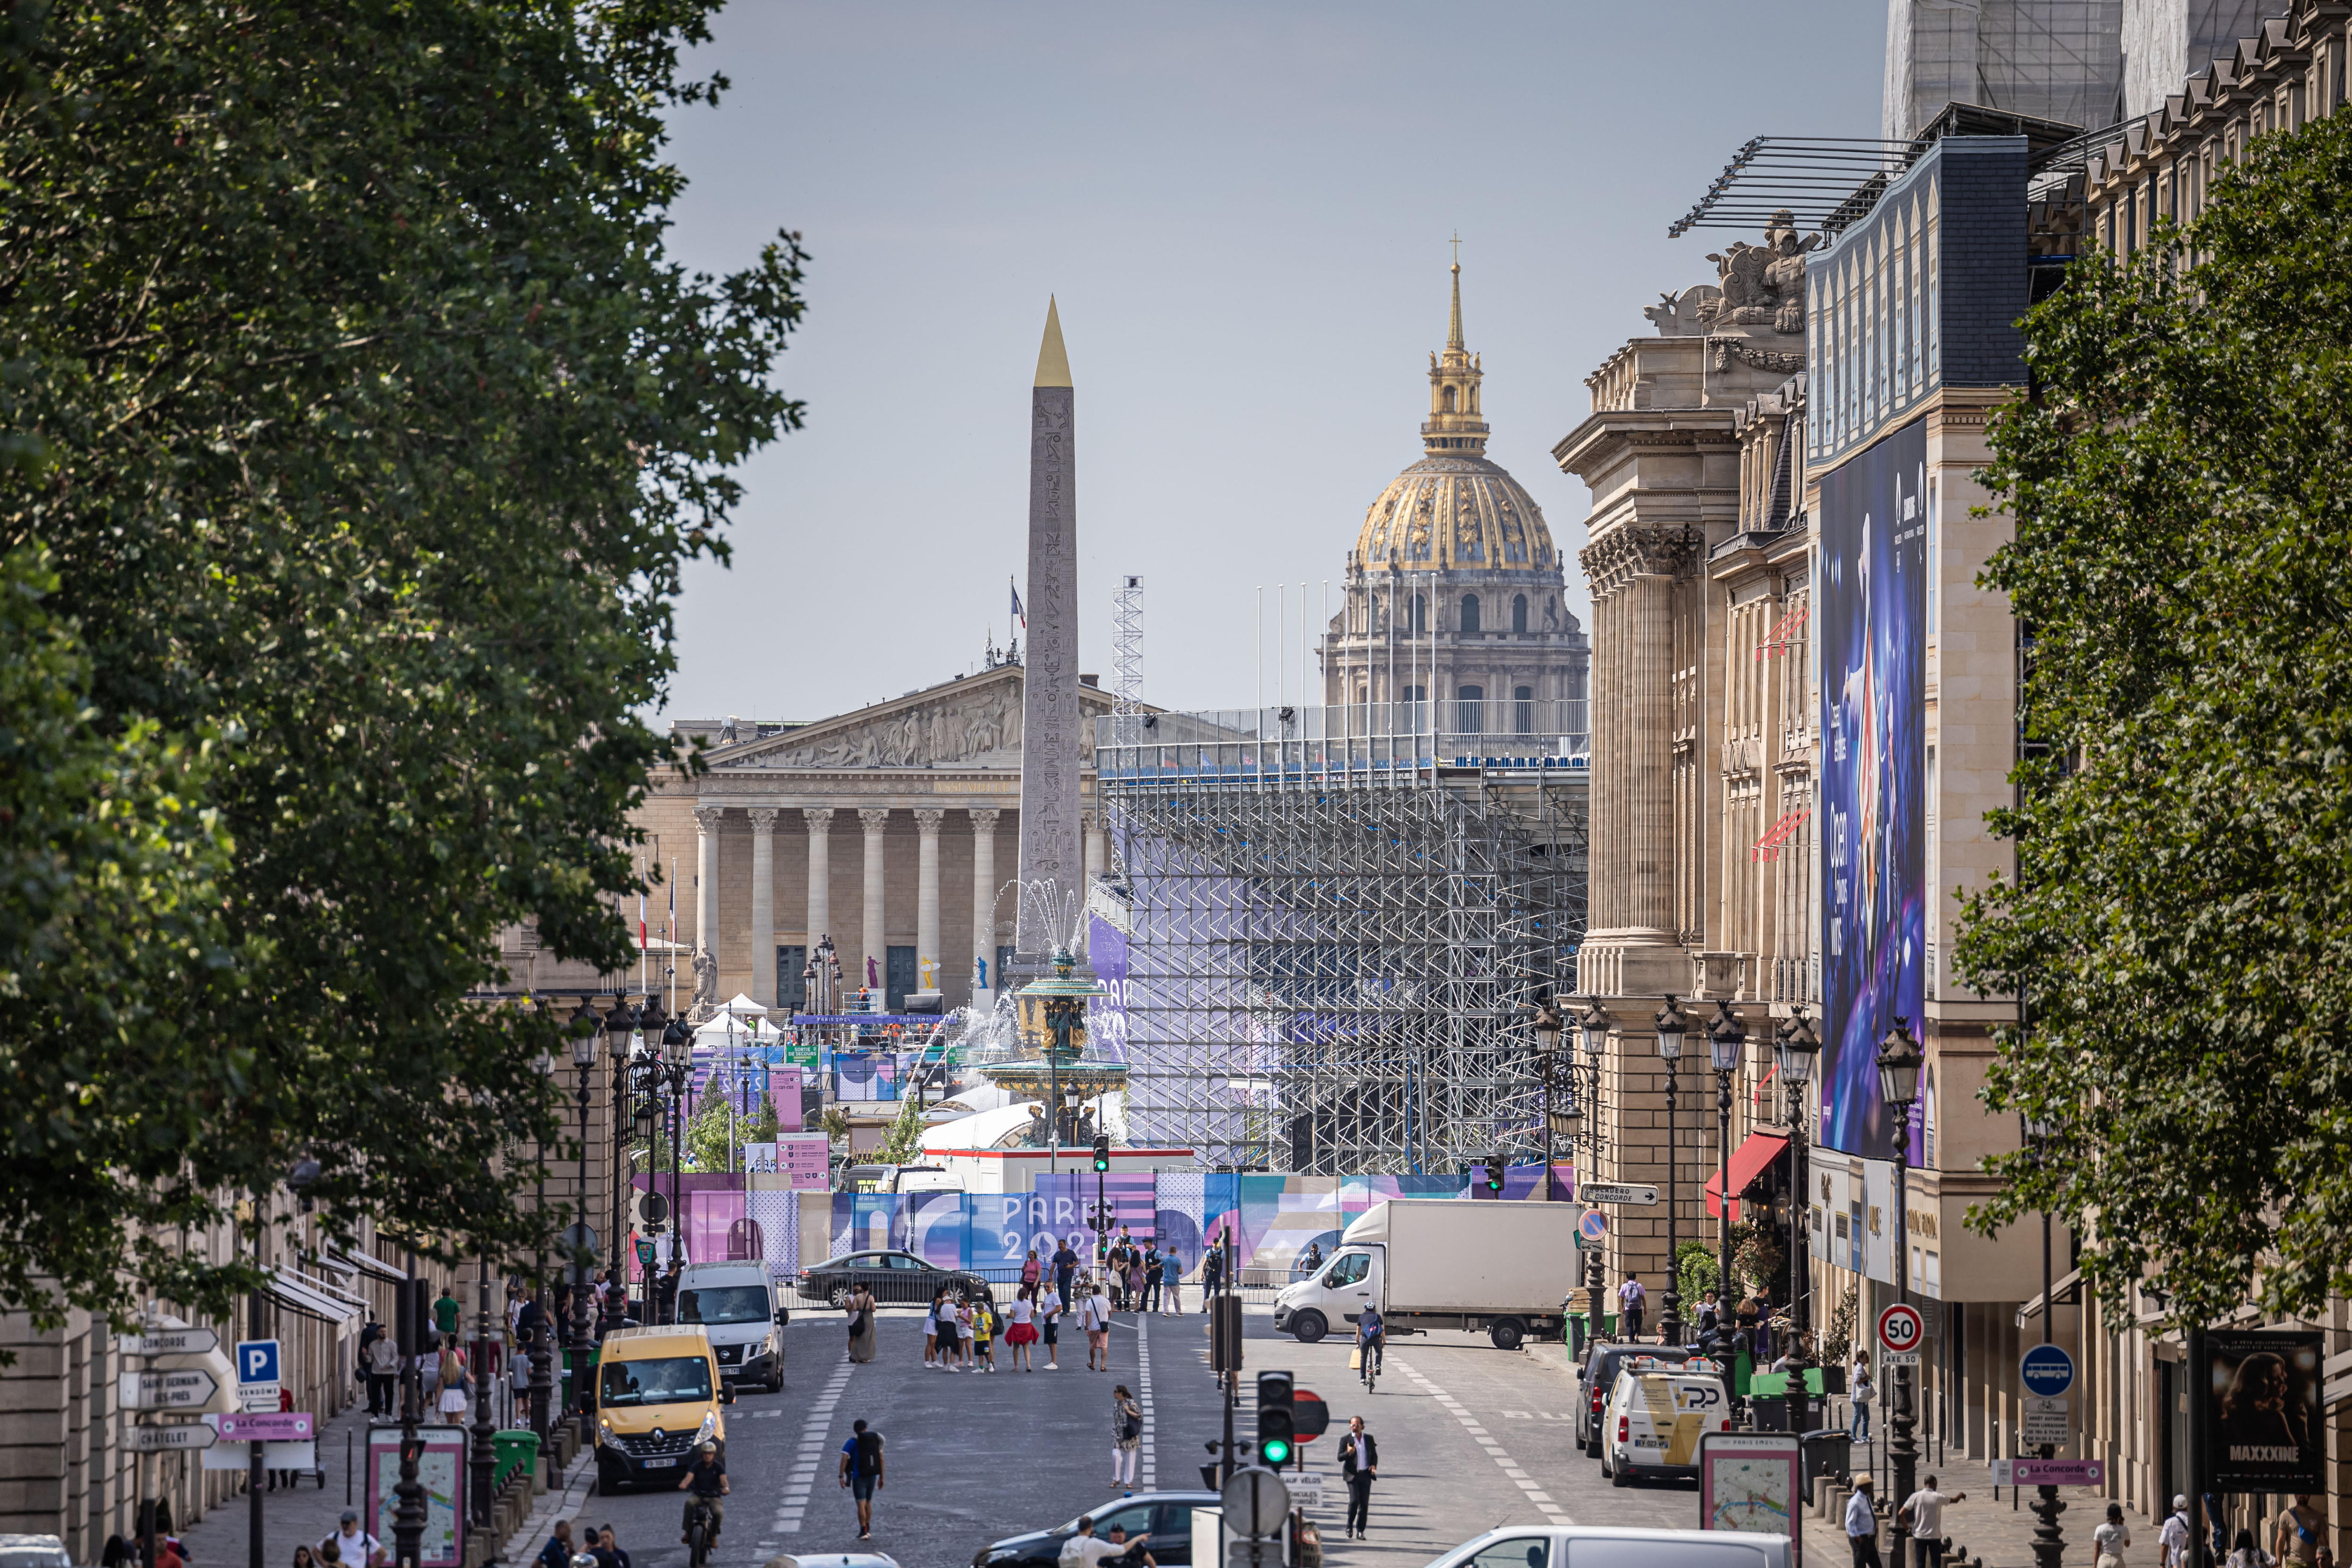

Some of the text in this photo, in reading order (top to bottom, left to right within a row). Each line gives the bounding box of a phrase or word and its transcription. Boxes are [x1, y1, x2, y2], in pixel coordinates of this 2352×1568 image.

[1830, 801, 1847, 891] Open
[1831, 904, 1842, 956] wins
[1888, 1320, 1914, 1338] 50
[143, 1337, 186, 1348] CONCORDE
[248, 1349, 268, 1377] P
[2230, 1445, 2299, 1462] MAXXXINE
[2030, 1464, 2085, 1473] La Concorde
